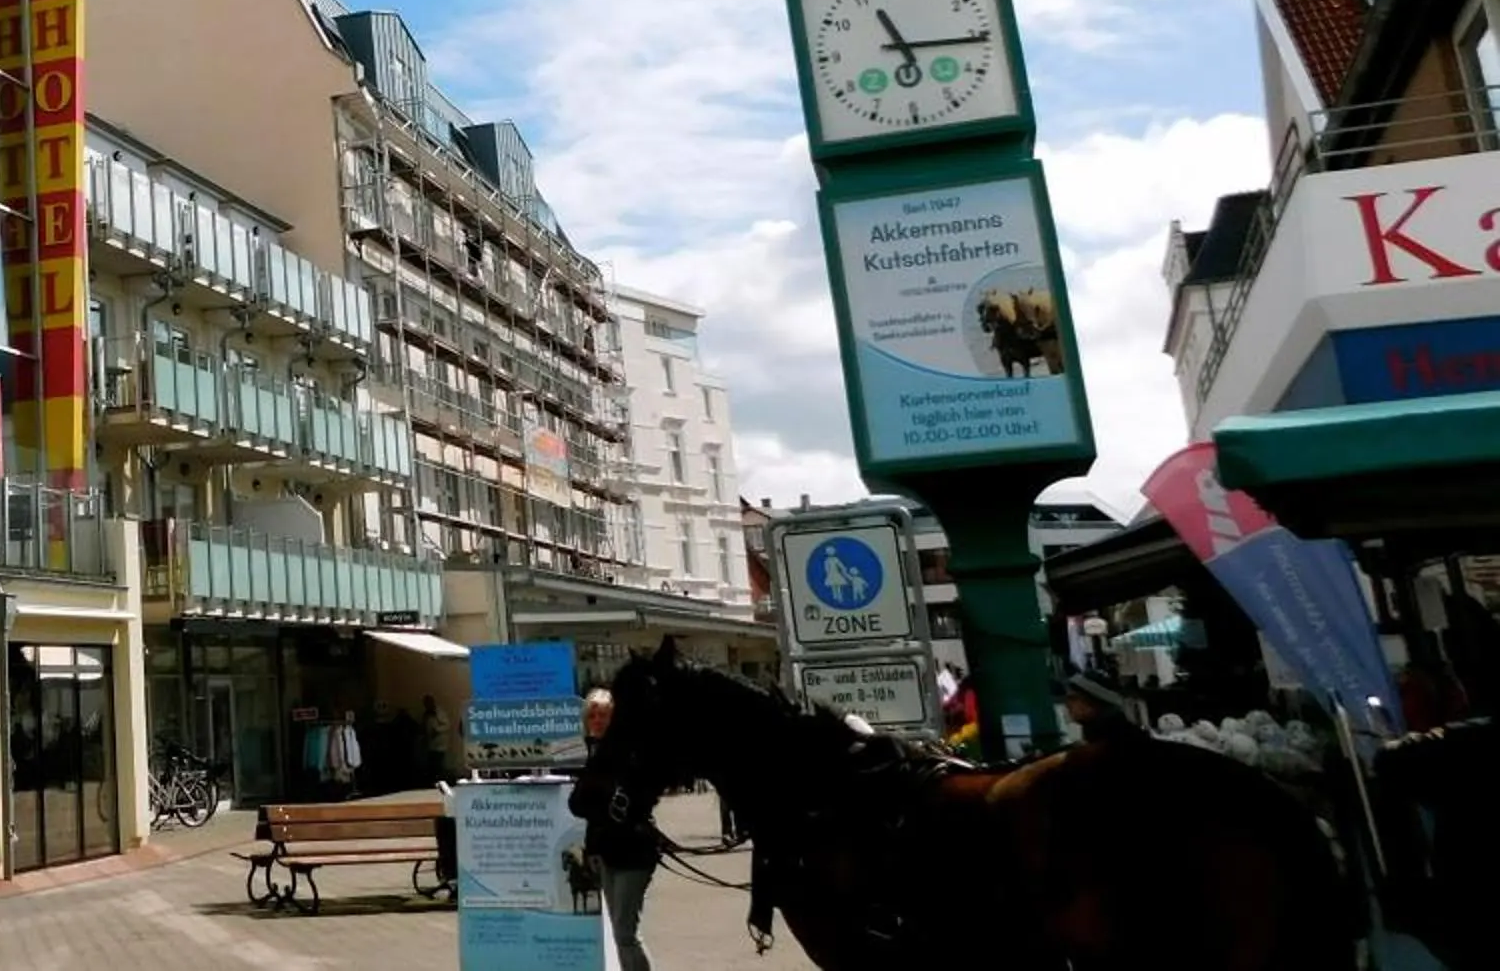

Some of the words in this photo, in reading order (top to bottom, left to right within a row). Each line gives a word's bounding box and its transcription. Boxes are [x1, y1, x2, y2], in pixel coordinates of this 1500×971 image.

[35, 5, 74, 319] HOTEL
[869, 213, 1004, 244] Akkermanns
[863, 241, 1019, 272] Kutschfahrten
[900, 382, 1031, 408] Kartenvorverkauf
[998, 406, 1025, 419] von
[823, 614, 883, 635] ZONE
[836, 670, 857, 684] und
[861, 667, 915, 684] Entladen
[832, 690, 853, 703] von
[470, 798, 547, 811] Akkermanns
[465, 815, 554, 830] Kutschfahrten
